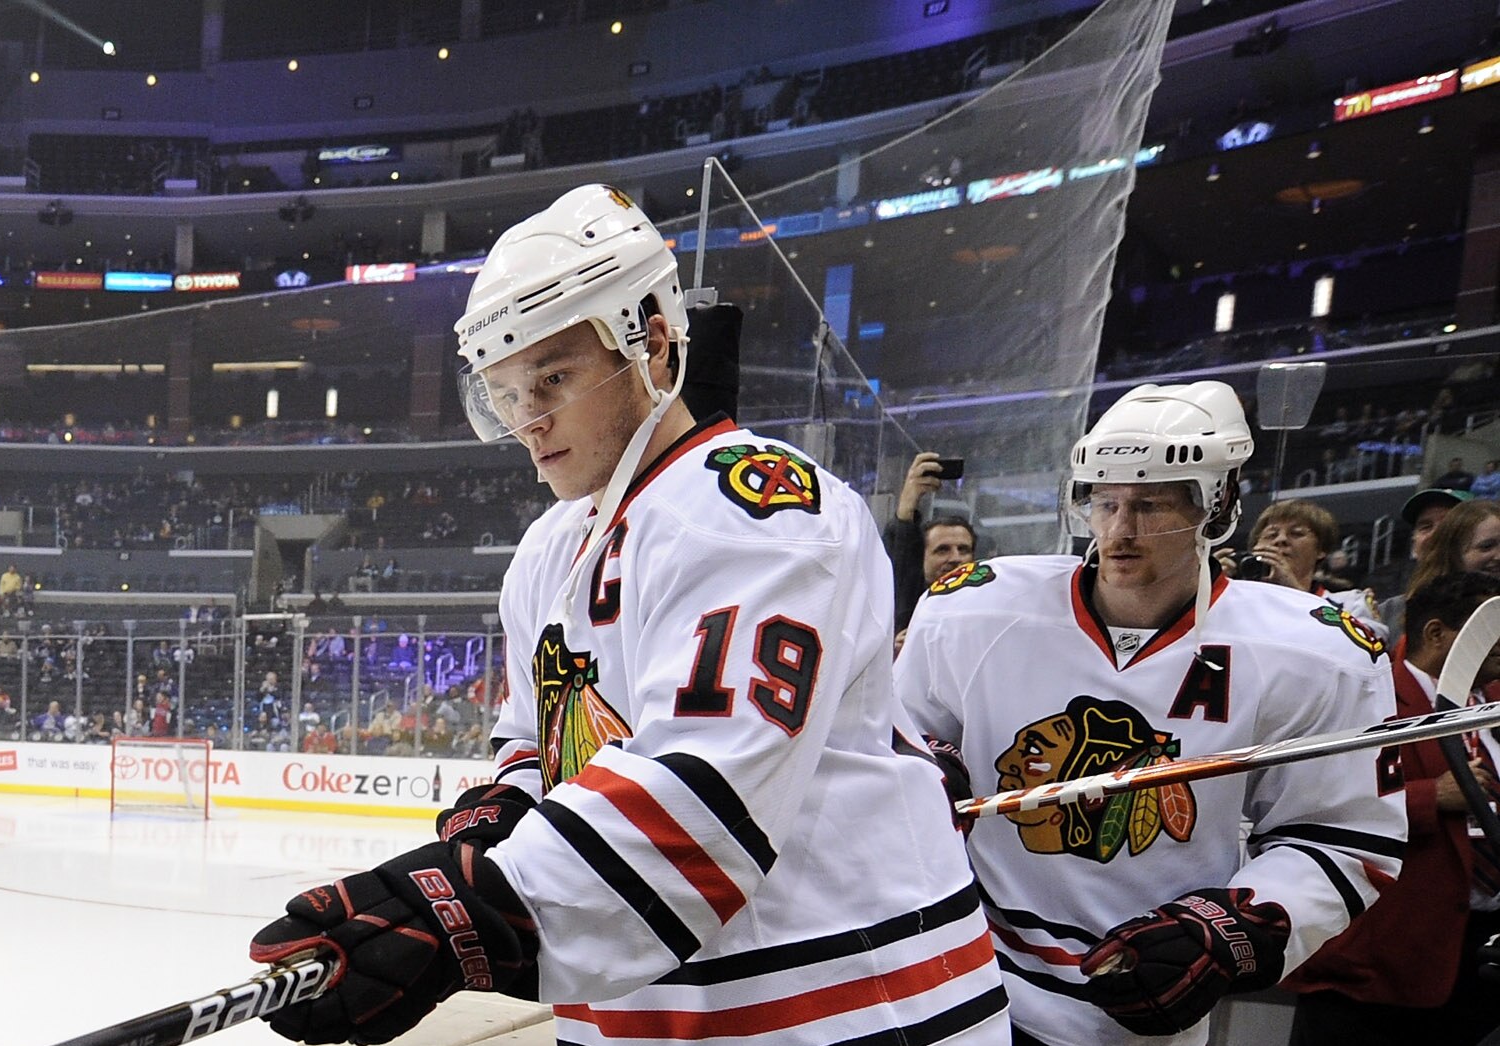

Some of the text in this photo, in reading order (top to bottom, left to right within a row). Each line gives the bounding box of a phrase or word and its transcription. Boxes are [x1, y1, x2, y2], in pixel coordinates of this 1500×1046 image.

[194, 274, 241, 290] TOYOTA
[467, 305, 509, 337] BAUER
[1096, 446, 1150, 456] CCM
[588, 516, 630, 627] C
[673, 604, 824, 738] 19
[1167, 644, 1232, 724] A
[144, 760, 242, 786] TOYOTA
[282, 762, 431, 799] Coke zero
[440, 805, 502, 843] UER
[408, 867, 494, 990] BAUER
[1173, 895, 1258, 977] BAUER
